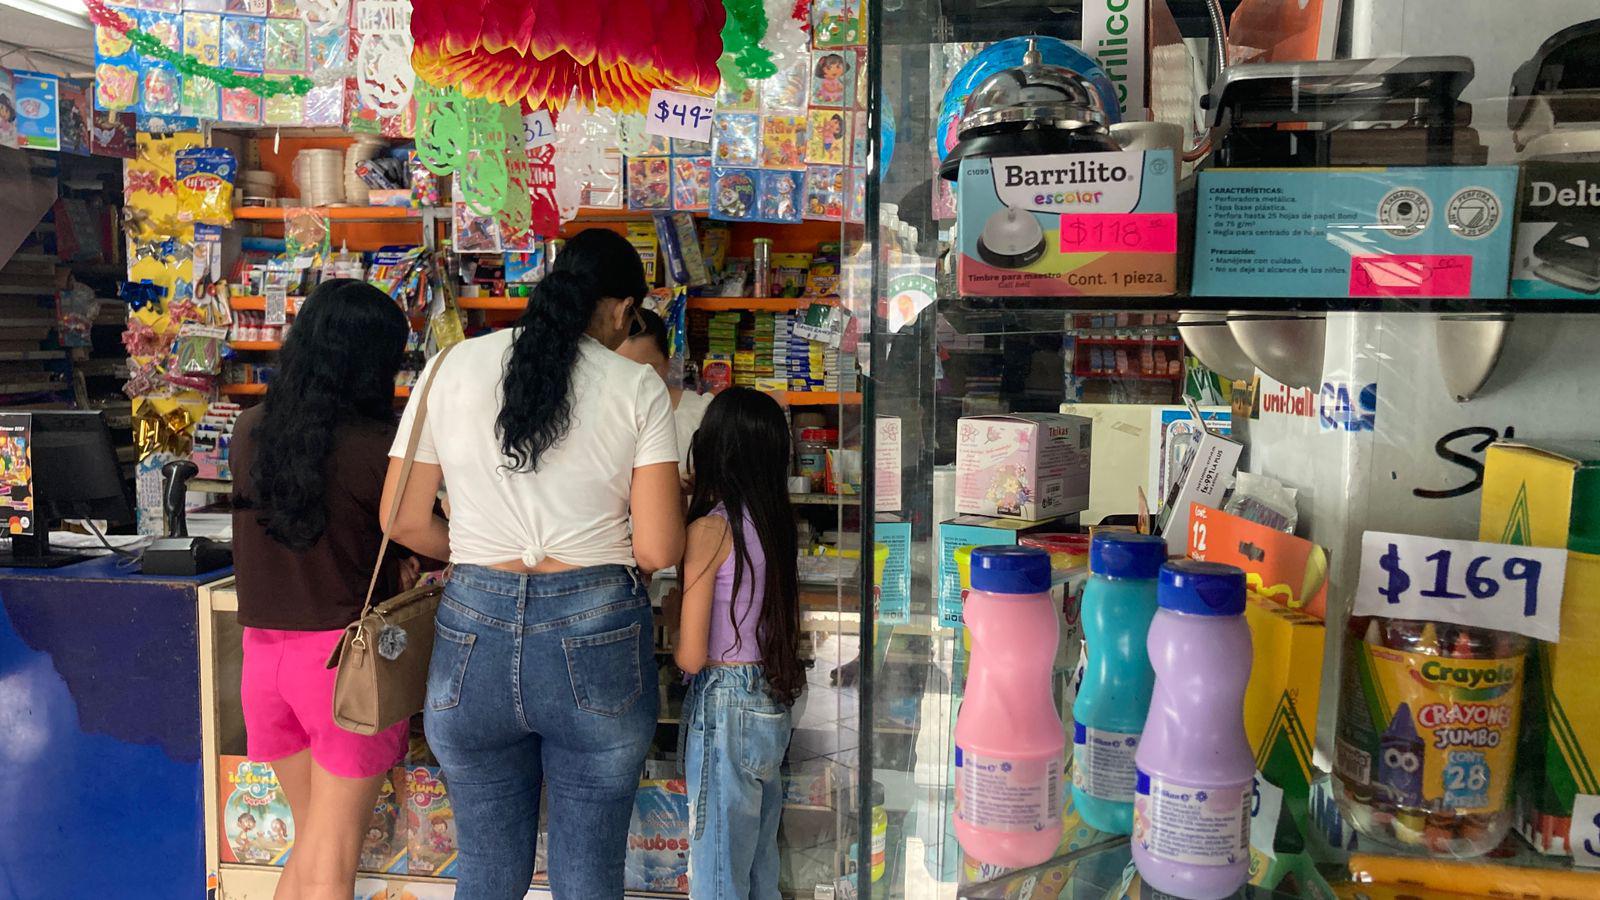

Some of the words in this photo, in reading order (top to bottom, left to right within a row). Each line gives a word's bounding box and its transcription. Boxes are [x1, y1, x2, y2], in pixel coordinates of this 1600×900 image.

[1096, 0, 1129, 113] crílico
[966, 168, 989, 176] C1099
[1004, 160, 1128, 187] Barrilito
[1034, 190, 1104, 205] escolar
[1209, 185, 1284, 194] CARACTERÍSTICAS:
[1215, 195, 1260, 203] Perforadora
[1457, 191, 1490, 203] PERFORA
[1279, 212, 1299, 221] hojas
[1313, 213, 1336, 222] papel
[1062, 217, 1142, 247] $118
[1236, 229, 1254, 237] para
[967, 273, 999, 282] Timbre
[1001, 273, 1023, 282] para
[1024, 272, 1062, 280] maestro
[1241, 266, 1256, 274] deje
[1067, 272, 1107, 286] Cont.
[1112, 272, 1119, 284] 1
[1123, 271, 1168, 289] pieza.
[1192, 520, 1207, 551] 12
[1378, 543, 1542, 617] $169
[1420, 660, 1515, 687] Crayola
[1418, 703, 1512, 729] CRAYONES
[1434, 729, 1500, 749] JUMBO
[1448, 764, 1487, 791] 28
[629, 832, 690, 852] Nubes
